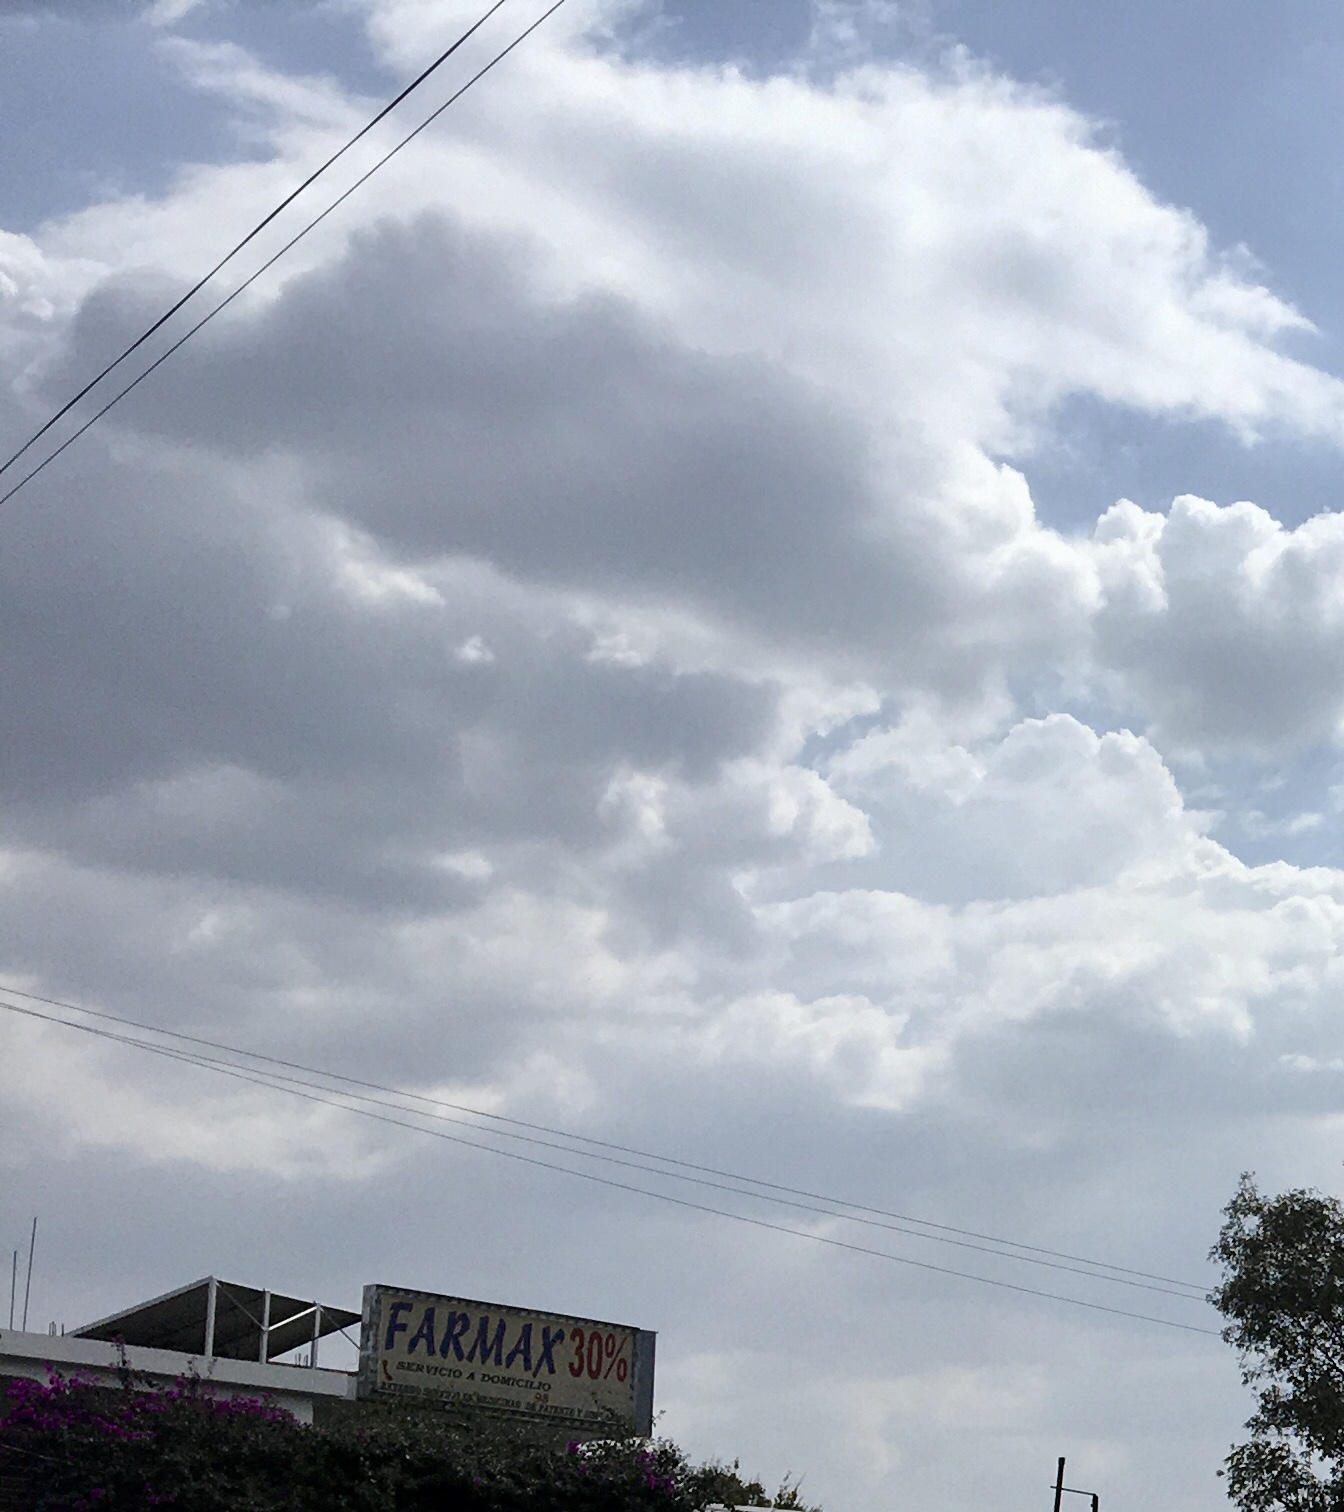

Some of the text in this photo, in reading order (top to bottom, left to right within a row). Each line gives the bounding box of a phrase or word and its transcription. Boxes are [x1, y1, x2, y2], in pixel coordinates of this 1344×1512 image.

[384, 1301, 629, 1382] FARMAX 30%
[396, 1361, 552, 1392] SERVICIO A DOMICILIO
